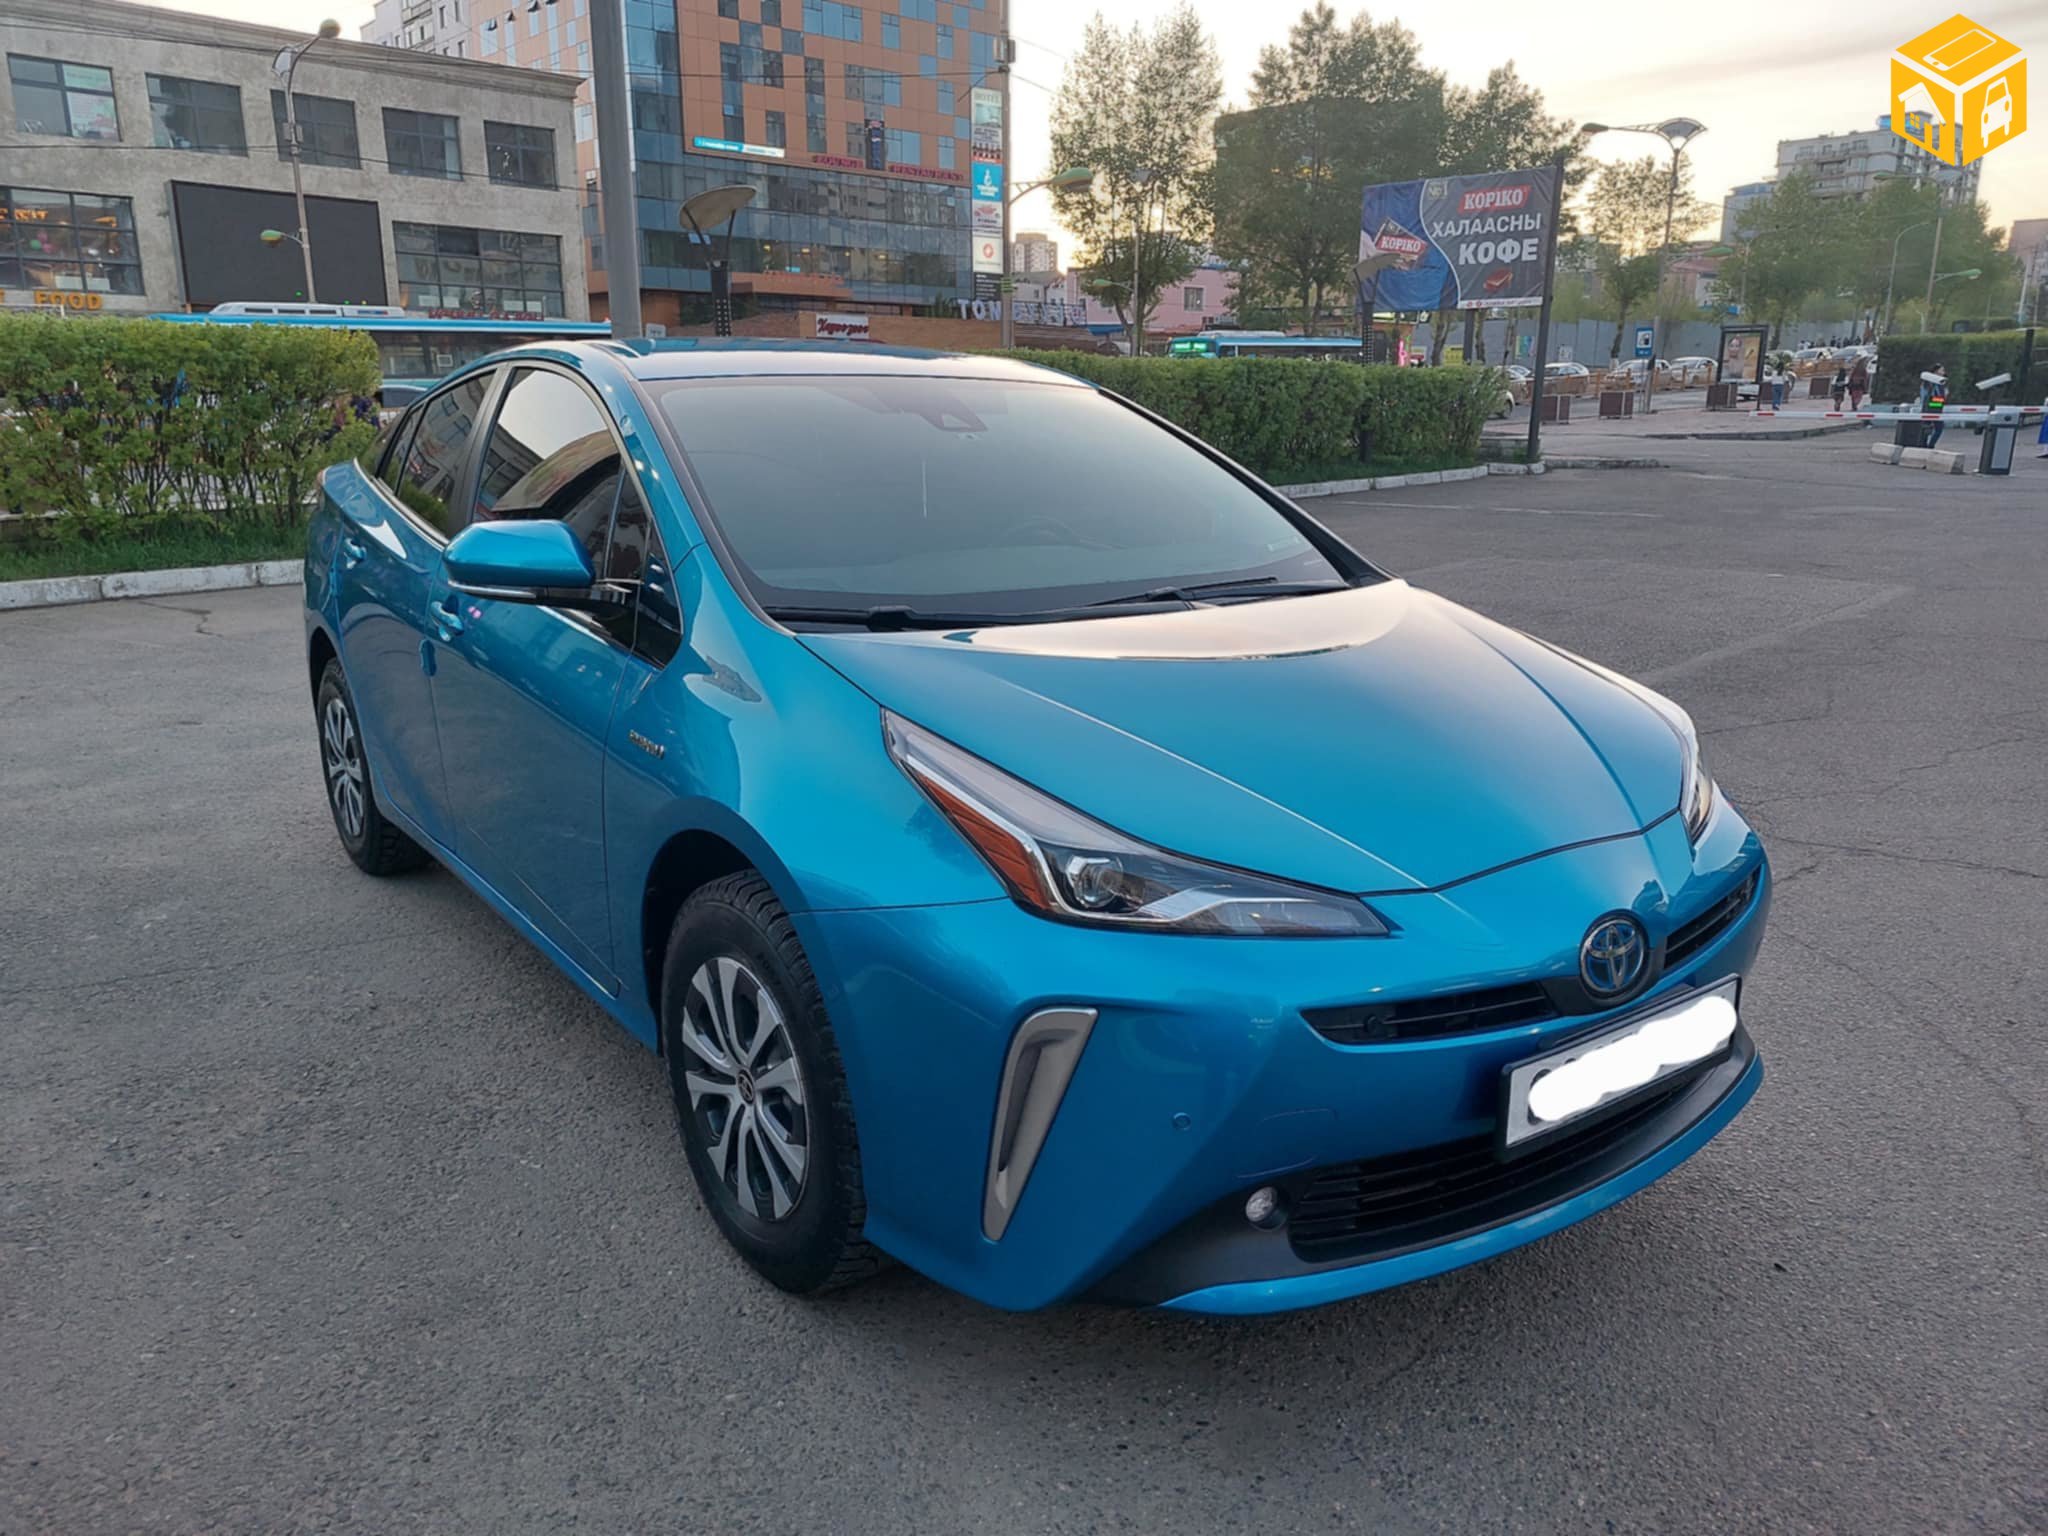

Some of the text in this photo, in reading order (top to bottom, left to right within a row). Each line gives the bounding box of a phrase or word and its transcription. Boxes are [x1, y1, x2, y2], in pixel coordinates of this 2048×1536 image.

[1463, 188, 1524, 210] KOPIKO
[1431, 213, 1542, 238] ХАЛААСНЫ
[1380, 235, 1421, 252] KOPIKO
[1458, 238, 1540, 266] КОФЕ
[34, 289, 103, 310] FOOD
